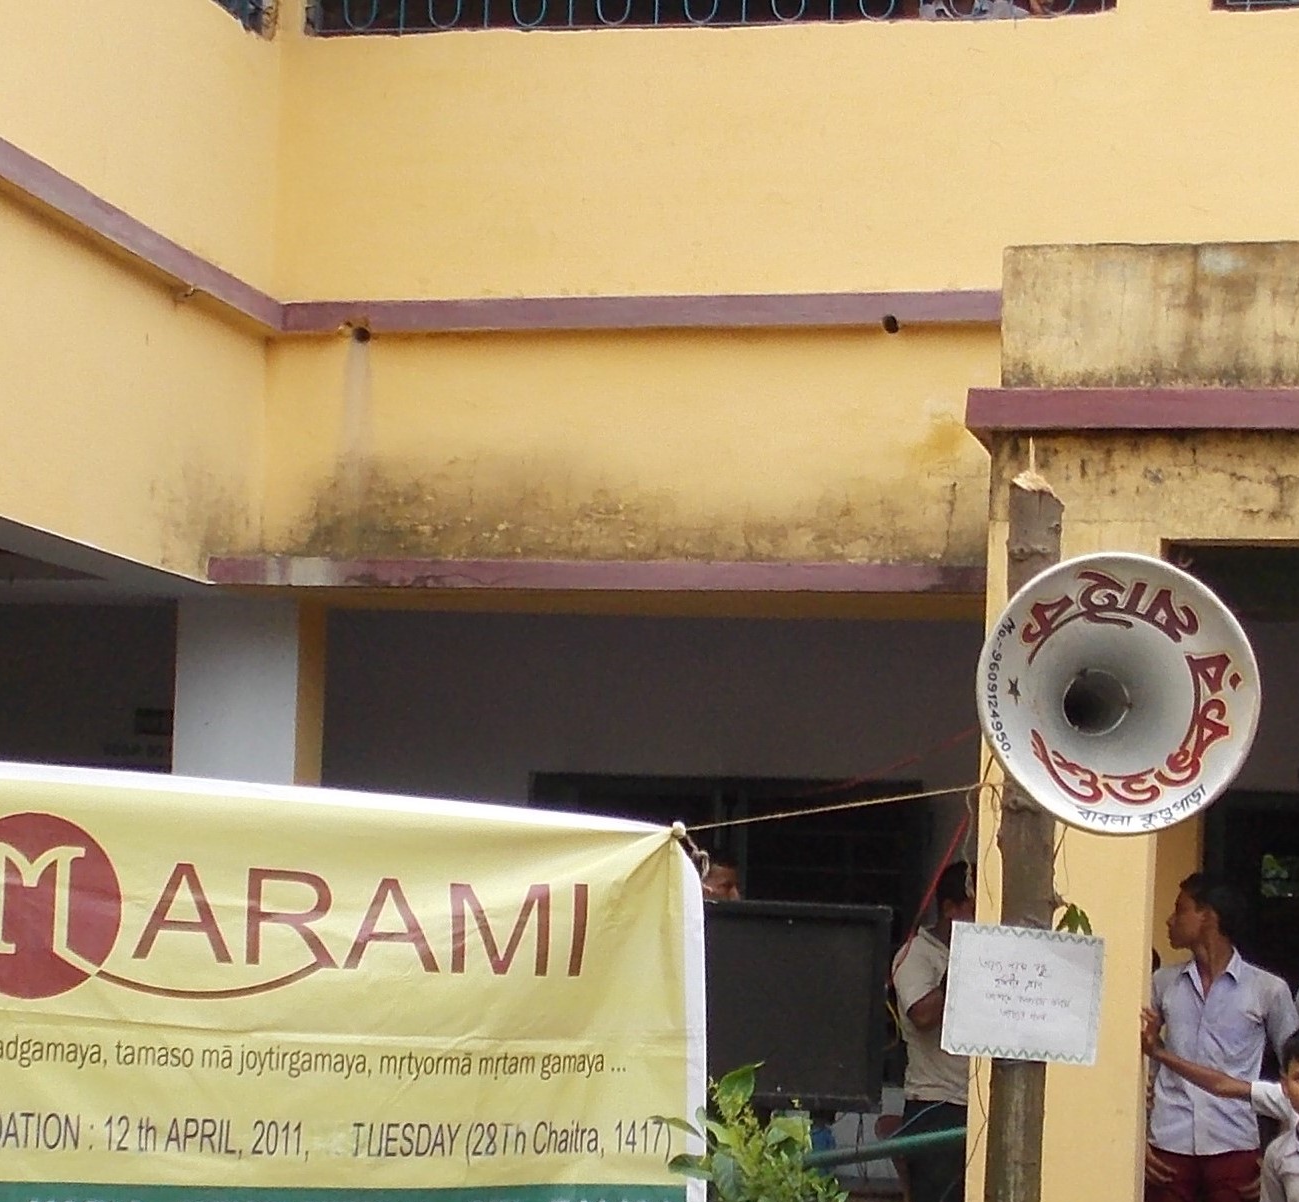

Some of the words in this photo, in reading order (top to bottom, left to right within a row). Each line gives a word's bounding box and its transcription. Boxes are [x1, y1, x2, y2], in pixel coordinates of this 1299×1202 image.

[1021, 571, 1199, 666] মাইক
[115, 1041, 194, 1068] tamaso
[202, 1041, 233, 1069] mā
[237, 1044, 372, 1079] joytirgamaya,
[540, 1051, 605, 1080] gamaya
[104, 1115, 131, 1152] 12
[138, 1117, 157, 1152] th
[165, 1117, 243, 1160] APRIL,
[251, 1120, 310, 1163] 2011,
[352, 1123, 462, 1158] TUESDAY
[533, 1120, 605, 1159] Chaitra,
